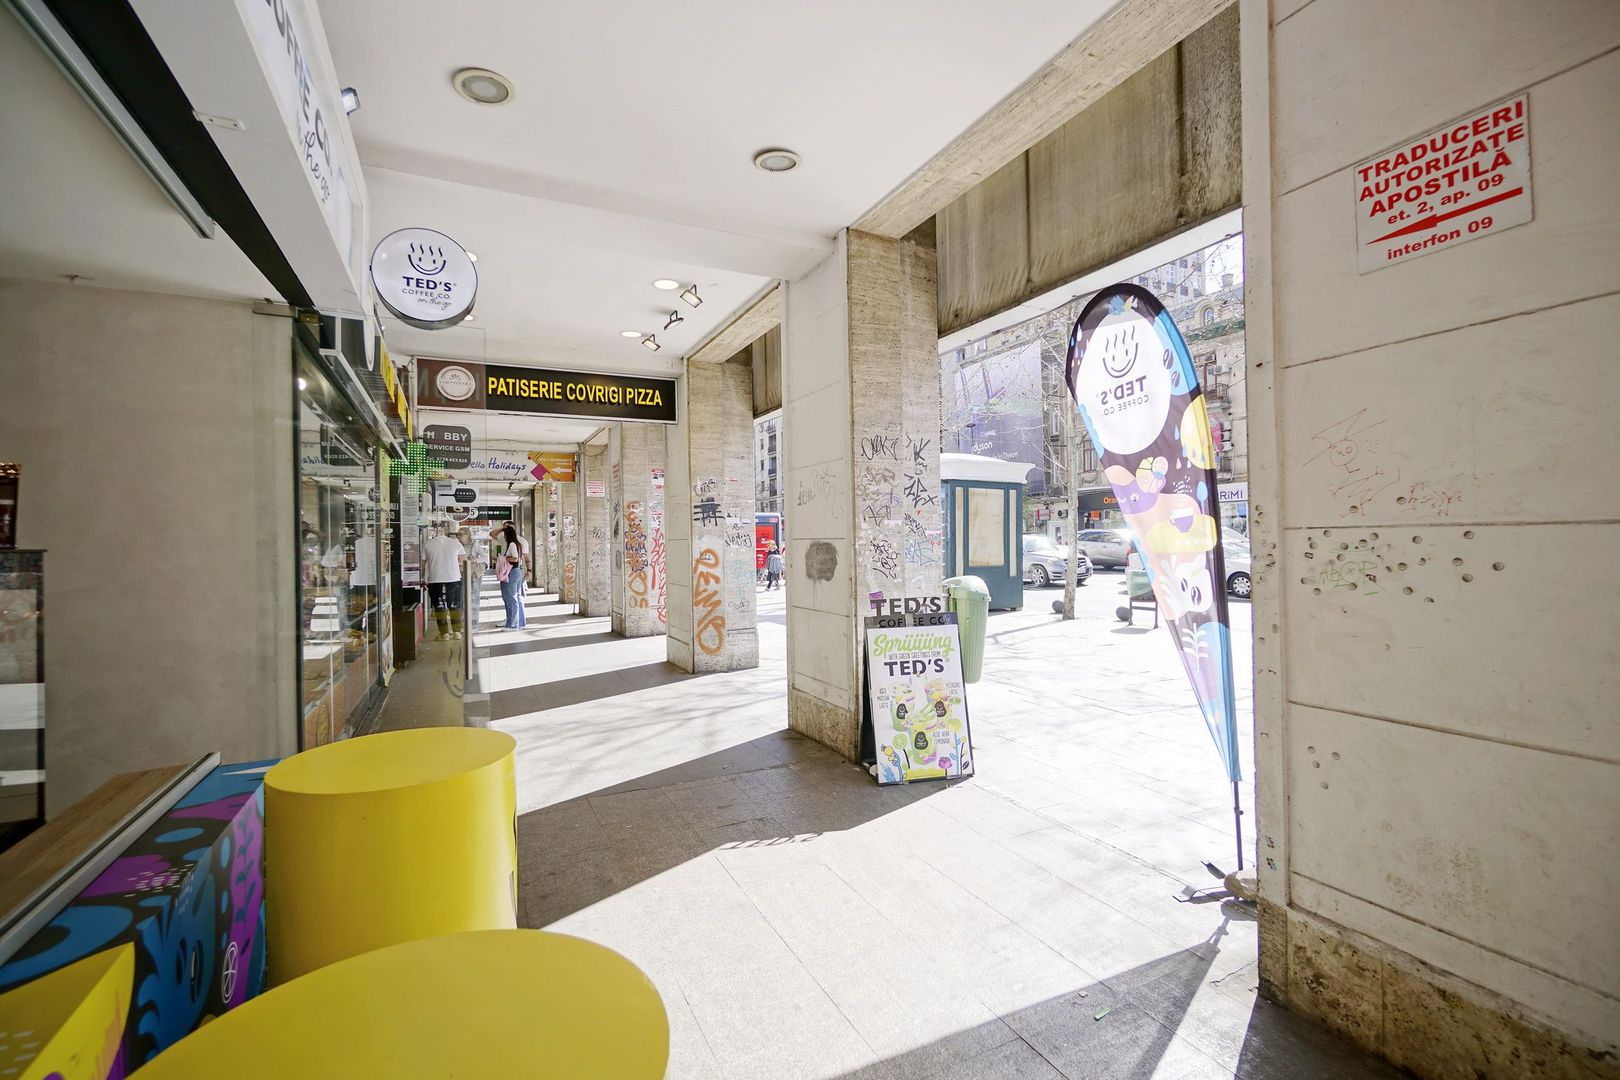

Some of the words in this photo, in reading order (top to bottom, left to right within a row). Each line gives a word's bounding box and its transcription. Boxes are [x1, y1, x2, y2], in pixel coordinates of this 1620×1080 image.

[266, 0, 311, 123] OFFEE
[1357, 101, 1523, 182] TRADUCERI
[1360, 123, 1524, 202] AUTORIZATE
[1369, 147, 1512, 217] APOSTILĂ
[1387, 208, 1411, 225] et.
[1417, 201, 1434, 216] 2,
[1440, 190, 1471, 206] ap.
[1477, 173, 1504, 192] 09
[1387, 228, 1461, 260] interfon
[1468, 216, 1493, 233] 09
[402, 275, 452, 292] TED'S
[402, 288, 434, 298] COFFEE
[488, 376, 562, 399] PATISERIE
[567, 383, 622, 405] COVRIGI
[626, 388, 663, 406] PIZZA
[425, 443, 454, 451] SERVICE
[973, 441, 993, 454] dyson
[471, 460, 485, 469] ello
[488, 457, 527, 476] Holidays
[870, 597, 942, 617] TED'S
[879, 616, 924, 628] COFEE
[884, 658, 944, 677] TED'S
